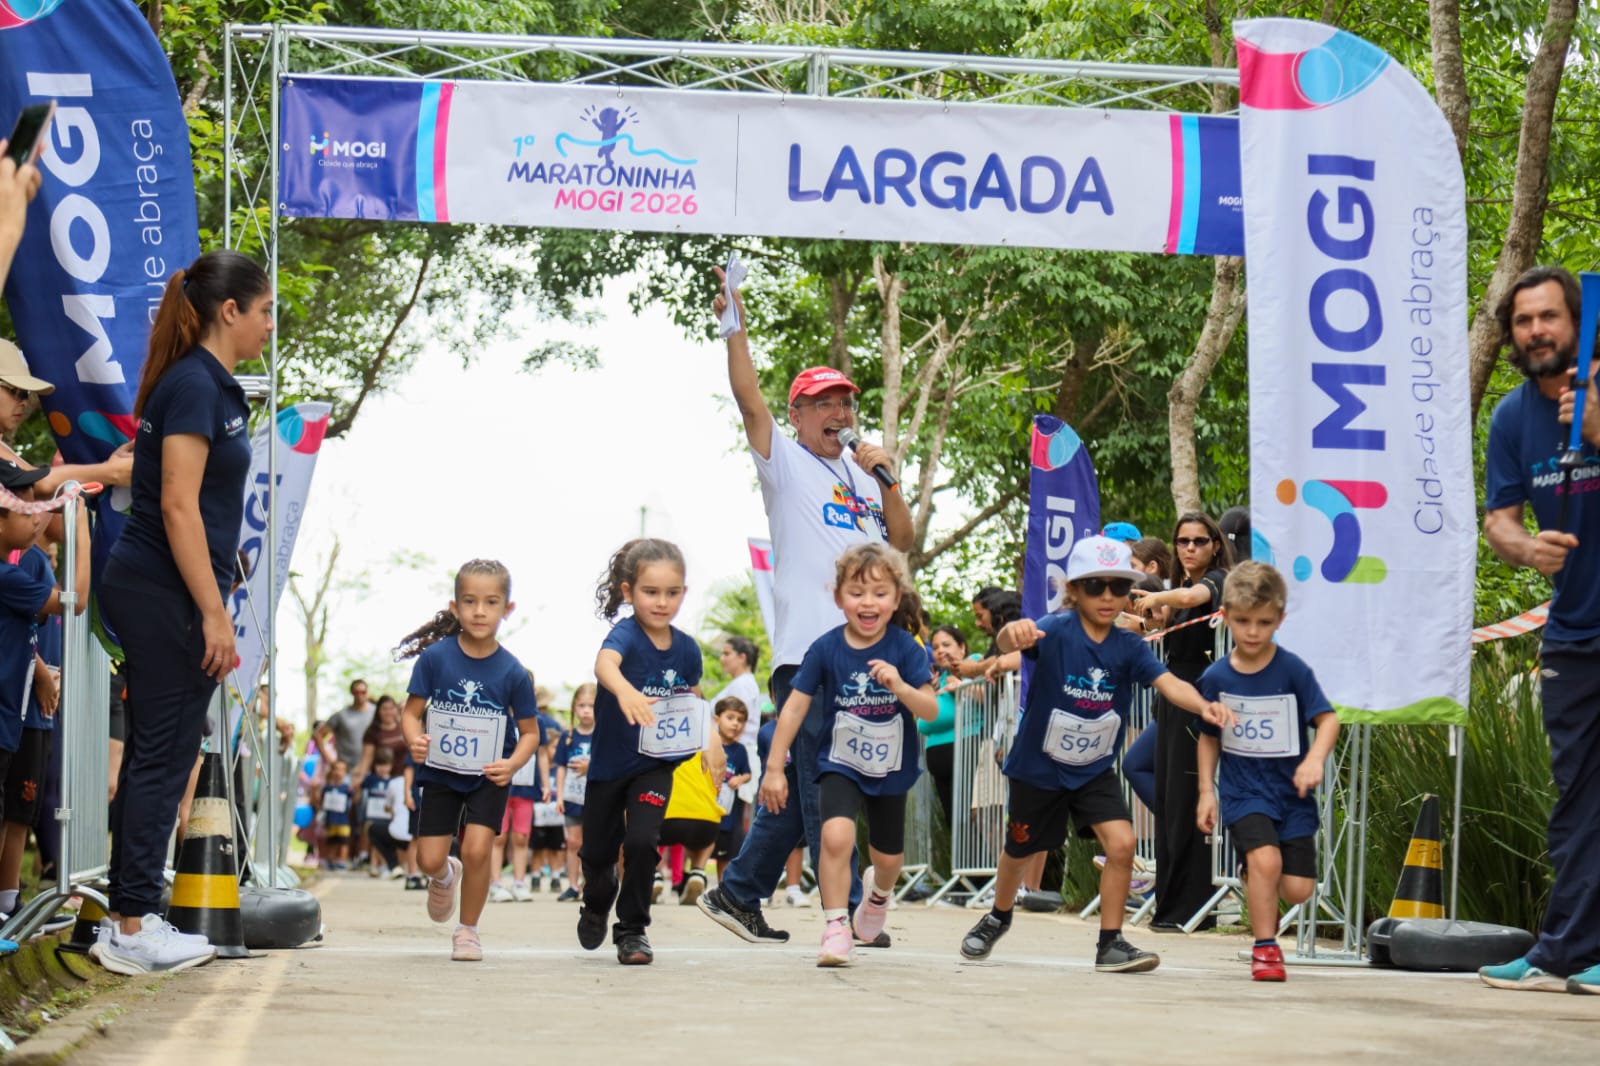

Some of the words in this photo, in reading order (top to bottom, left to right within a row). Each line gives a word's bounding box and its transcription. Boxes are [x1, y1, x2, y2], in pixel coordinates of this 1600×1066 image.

[333, 141, 387, 158] MOGI
[512, 135, 535, 158] 1º
[131, 118, 163, 246] abraça
[507, 161, 696, 191] MARATONINHA
[788, 143, 1115, 216] LARGADA
[554, 188, 624, 213] MOGI
[629, 192, 698, 215] 2026
[26, 72, 126, 385] MOGI
[1402, 206, 1441, 326] abraça
[1307, 154, 1387, 451] MOGI
[1410, 336, 1441, 403] que
[1413, 412, 1444, 535] Cidade
[1045, 495, 1076, 614] OGI
[872, 704, 896, 716] 202
[656, 716, 691, 741] 554
[439, 733, 479, 758] 681
[846, 737, 889, 762] 489
[1060, 734, 1102, 754] 594
